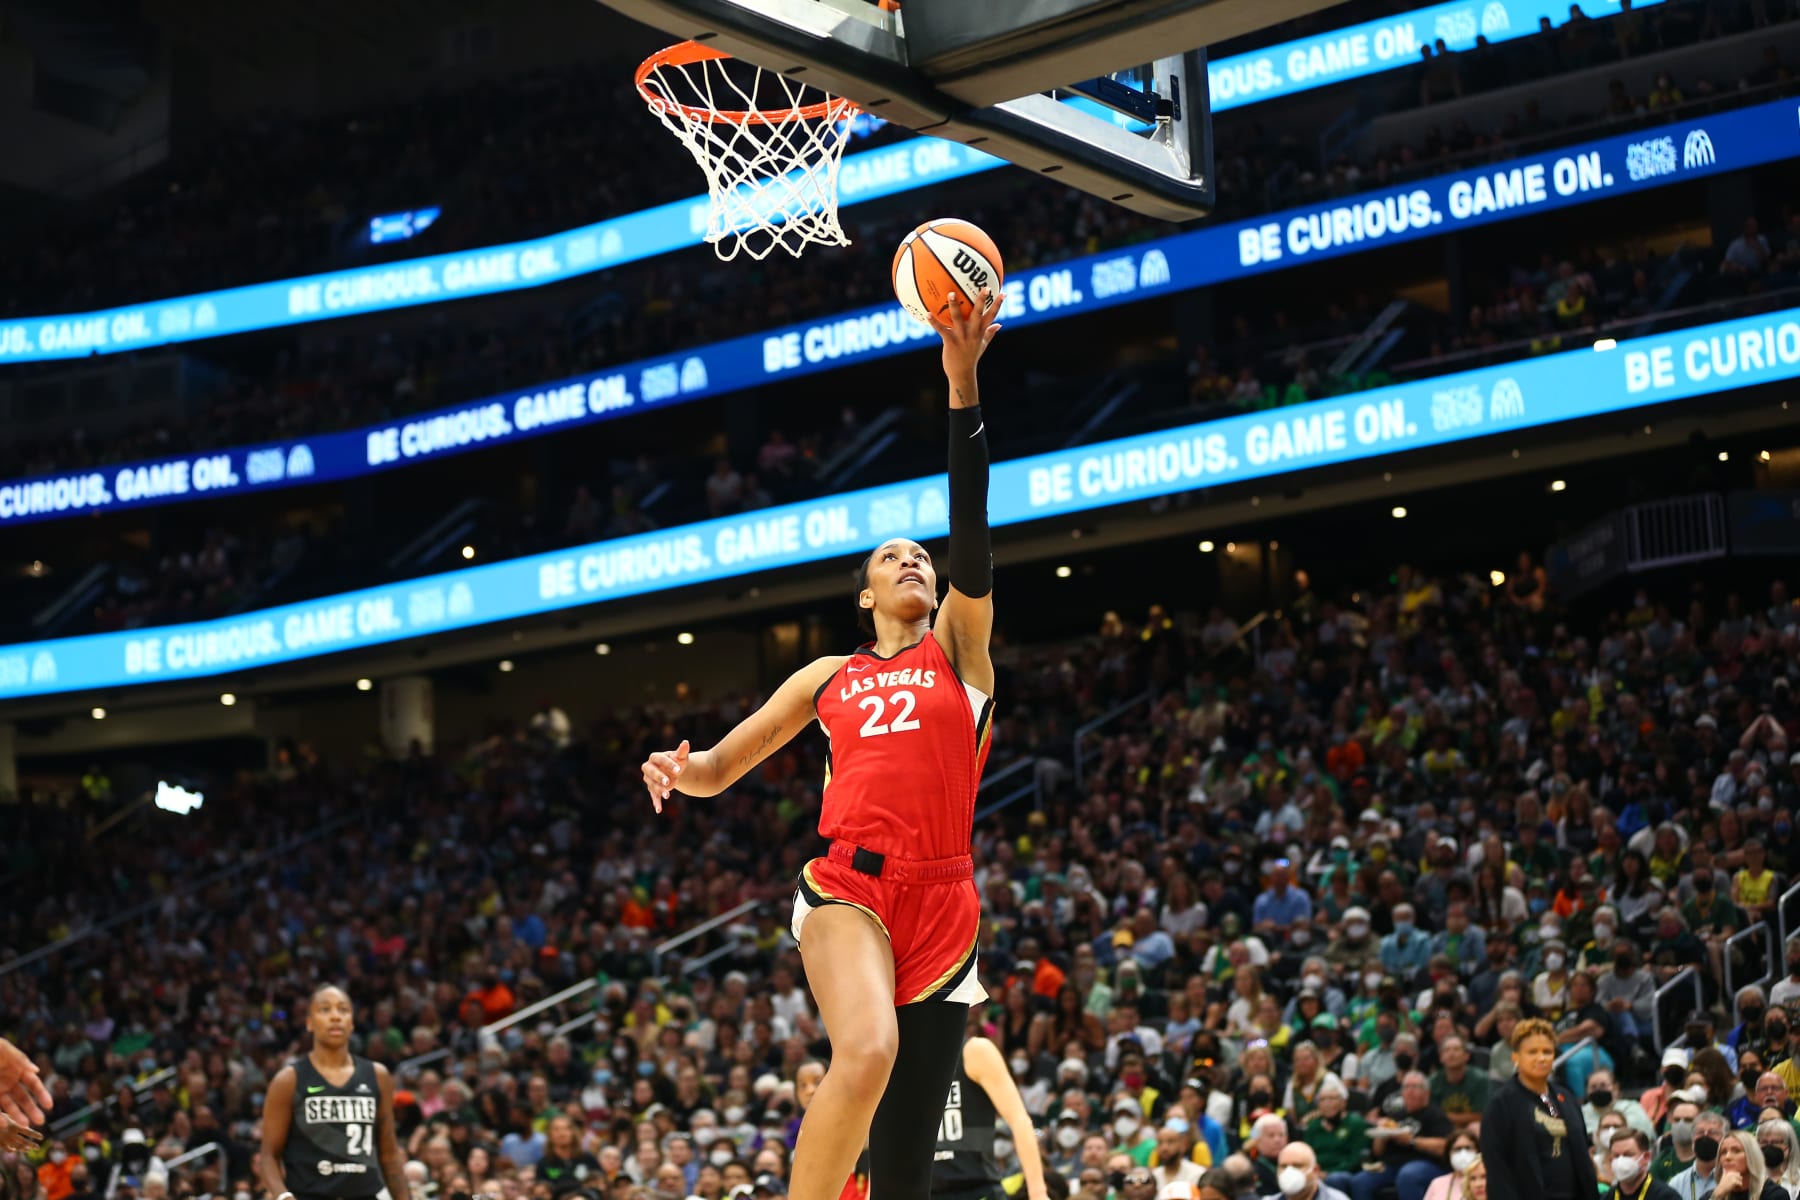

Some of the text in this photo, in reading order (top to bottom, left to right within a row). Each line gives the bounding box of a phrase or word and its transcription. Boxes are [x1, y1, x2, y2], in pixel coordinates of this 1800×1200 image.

[1286, 33, 1370, 83] GAME
[1373, 21, 1423, 61] ON.
[838, 149, 912, 197] GAME
[912, 139, 960, 177] ON.
[1238, 151, 1614, 266] BE CURIOUS. GAME ON.
[288, 283, 322, 316] BE
[323, 265, 441, 310] CURIOUS.
[442, 247, 517, 291] GAME
[518, 245, 562, 280] ON.
[1029, 270, 1083, 311] ON.
[39, 318, 108, 351] GAME
[111, 312, 151, 343] ON.
[763, 332, 801, 373] BE
[1624, 322, 1800, 393] BE CURIO
[367, 429, 399, 465] BE
[400, 404, 512, 457] CURIOUS.
[514, 384, 586, 430] GAME
[588, 375, 634, 413] ON.
[1028, 463, 1075, 508] BE
[1078, 433, 1239, 498] CURIOUS.
[1244, 409, 1347, 466] GAME
[1353, 398, 1418, 445] ON.
[0, 474, 112, 518] CURIOUS.
[115, 461, 189, 501] GAME
[192, 455, 239, 491] ON.
[538, 558, 577, 600] BE
[578, 533, 713, 592] CURIOUS.
[714, 514, 802, 566] GAME
[803, 504, 860, 549] ON.
[125, 638, 162, 674] BE
[166, 620, 282, 670] CURIOUS.
[284, 604, 354, 650] GAME
[356, 597, 402, 635] ON.
[840, 667, 936, 703] LAS VEGAS
[857, 690, 921, 738] 22
[307, 1099, 374, 1121] SEATTLE
[346, 1123, 372, 1156] 24
